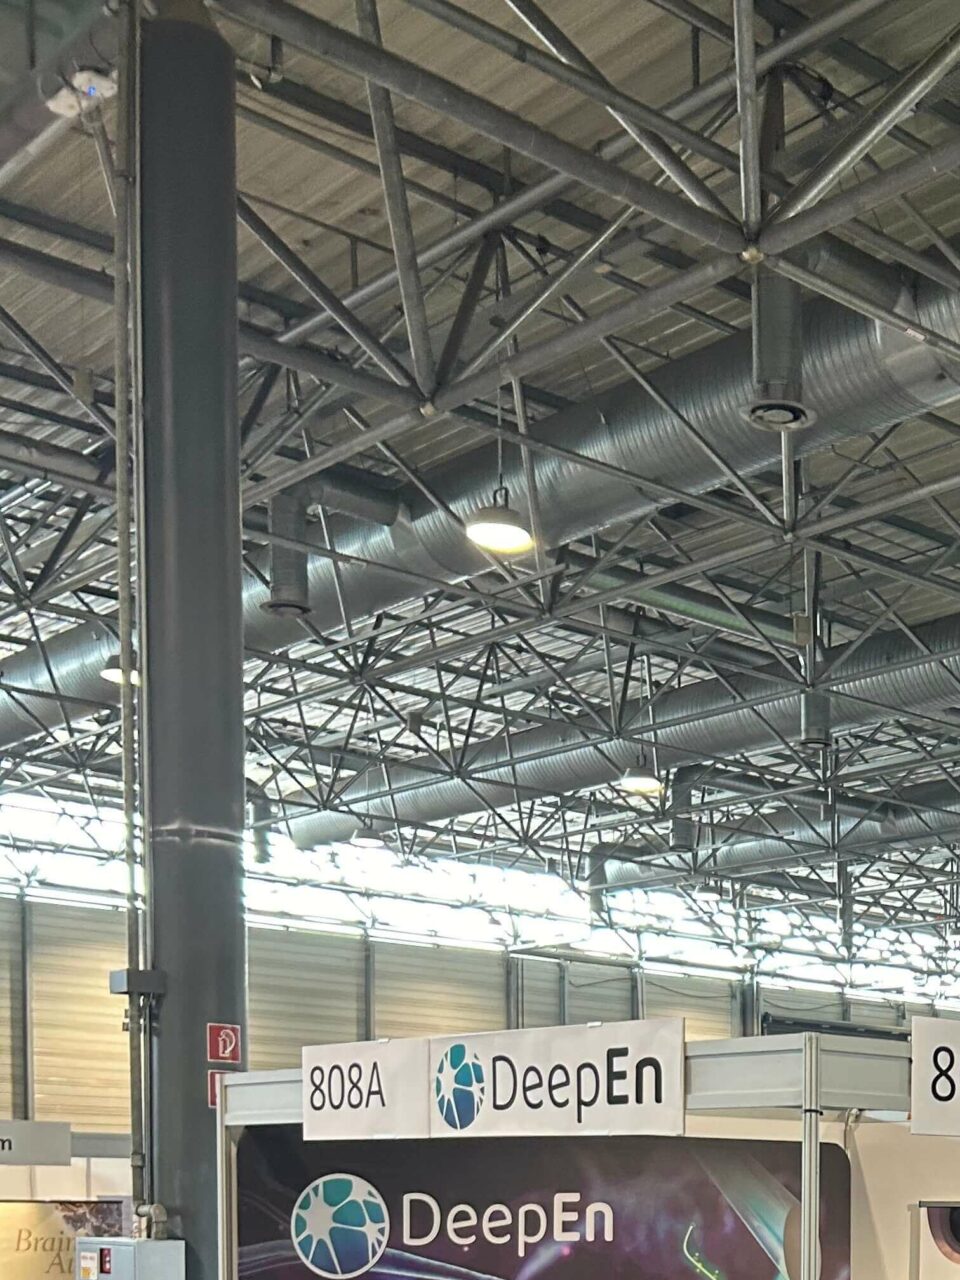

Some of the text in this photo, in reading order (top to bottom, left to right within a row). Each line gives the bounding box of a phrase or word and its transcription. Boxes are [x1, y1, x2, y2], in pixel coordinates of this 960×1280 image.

[310, 1047, 663, 1124] 808A DeepEn
[402, 1192, 614, 1258] DeepEn
